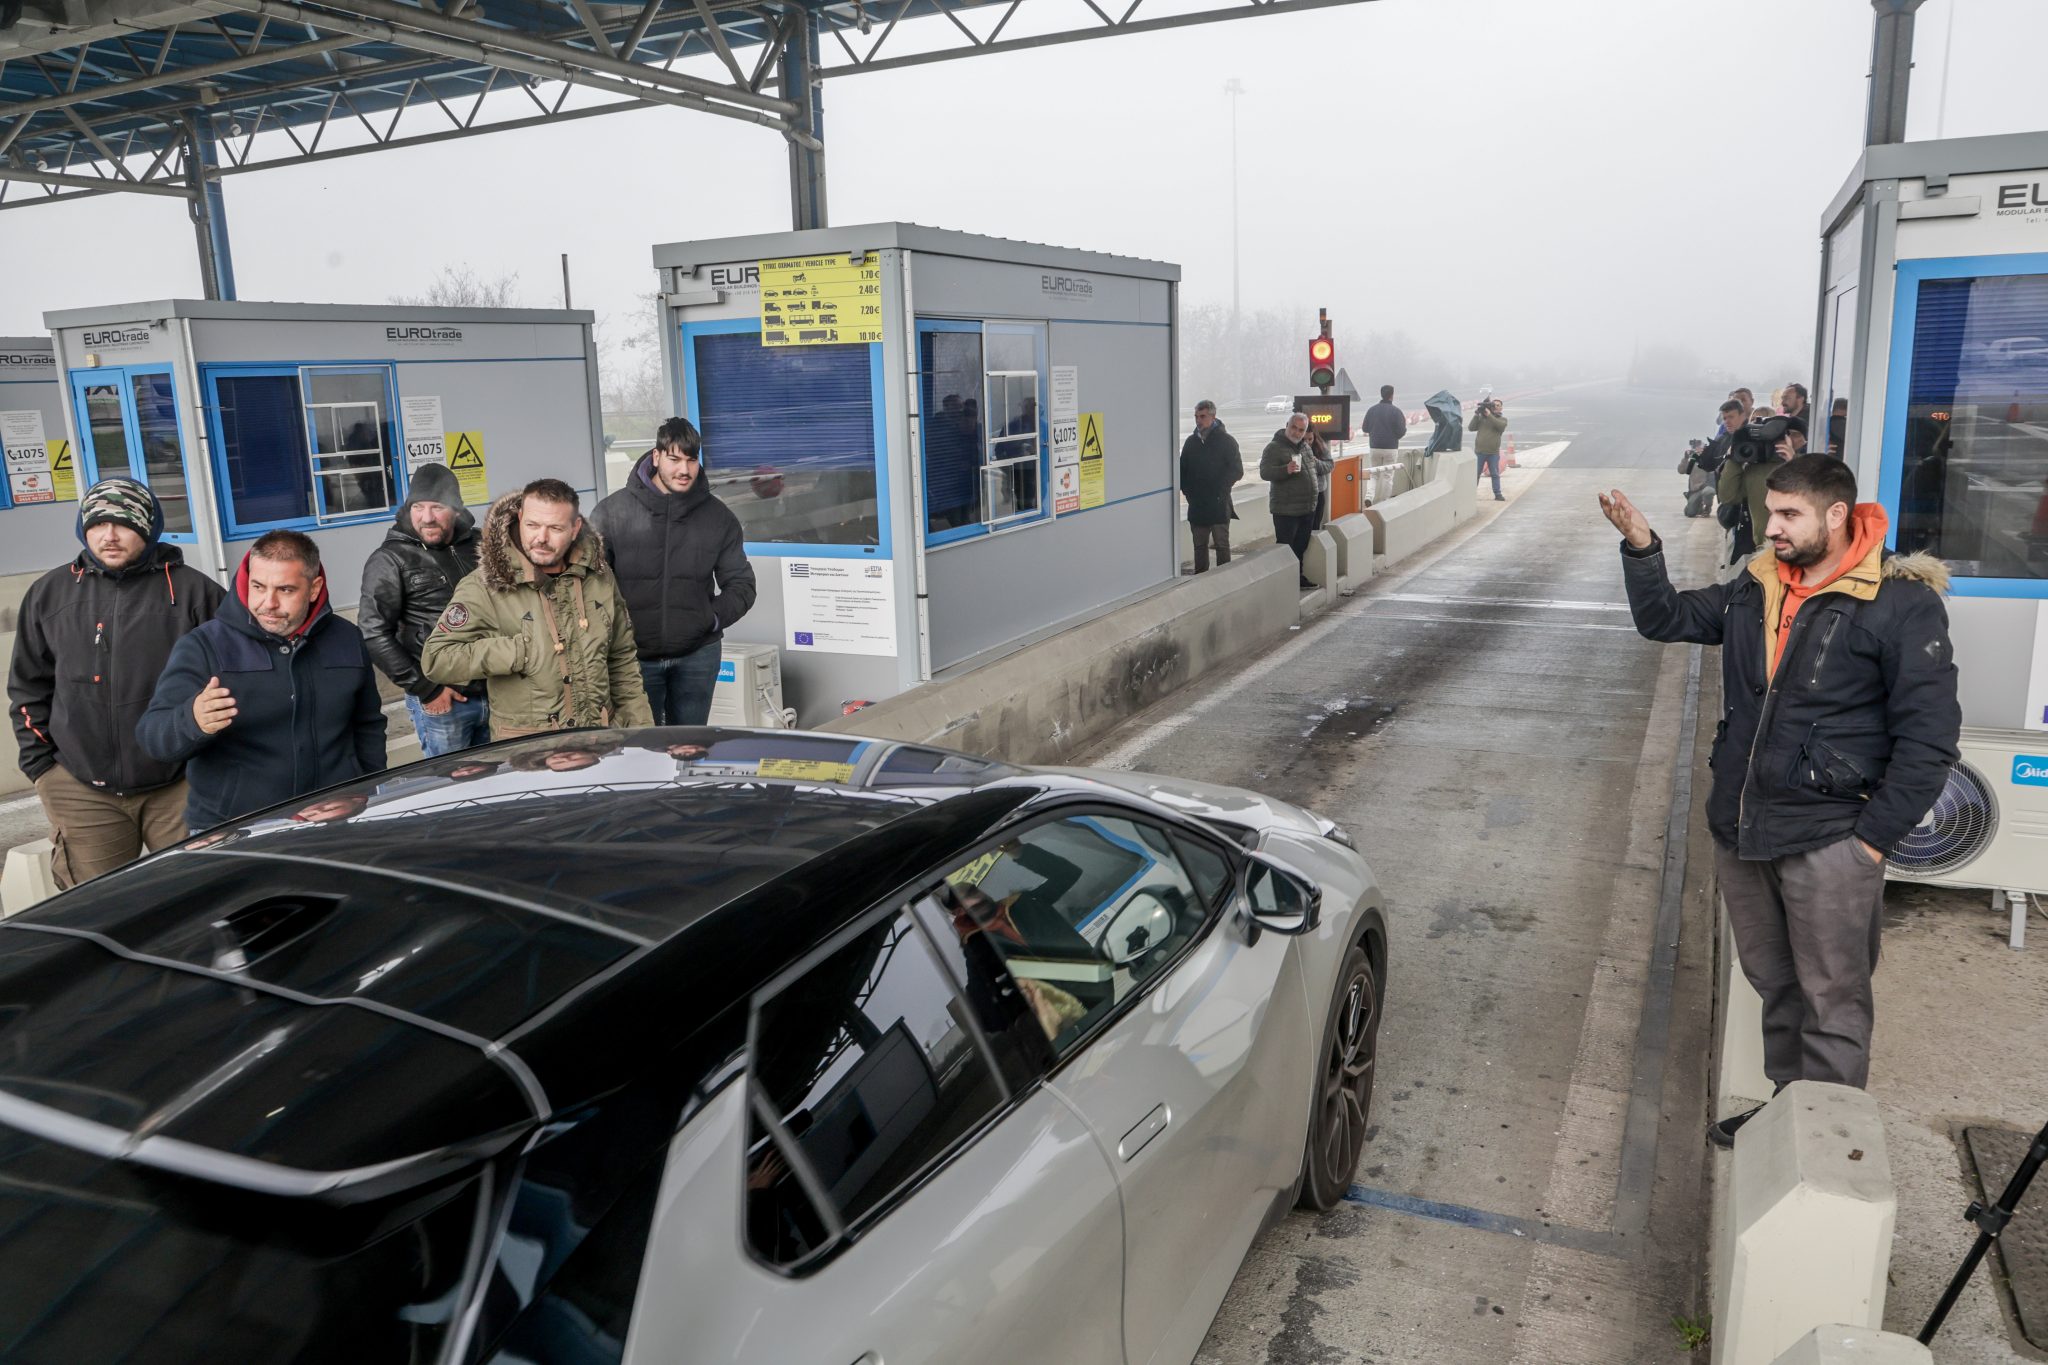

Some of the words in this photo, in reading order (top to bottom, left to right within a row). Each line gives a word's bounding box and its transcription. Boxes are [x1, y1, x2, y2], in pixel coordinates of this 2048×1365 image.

[1997, 208, 2041, 216] MODULAR
[805, 259, 823, 267] VEHICLE
[824, 258, 837, 266] TYPE
[1042, 275, 1093, 293] EUROtrade
[83, 330, 149, 345] EUROtrade
[386, 327, 462, 339] EUROtrade
[1311, 414, 1332, 423] STOP
[1059, 426, 1077, 443] 1075
[17, 448, 45, 459] 1075
[416, 443, 443, 456] 1075
